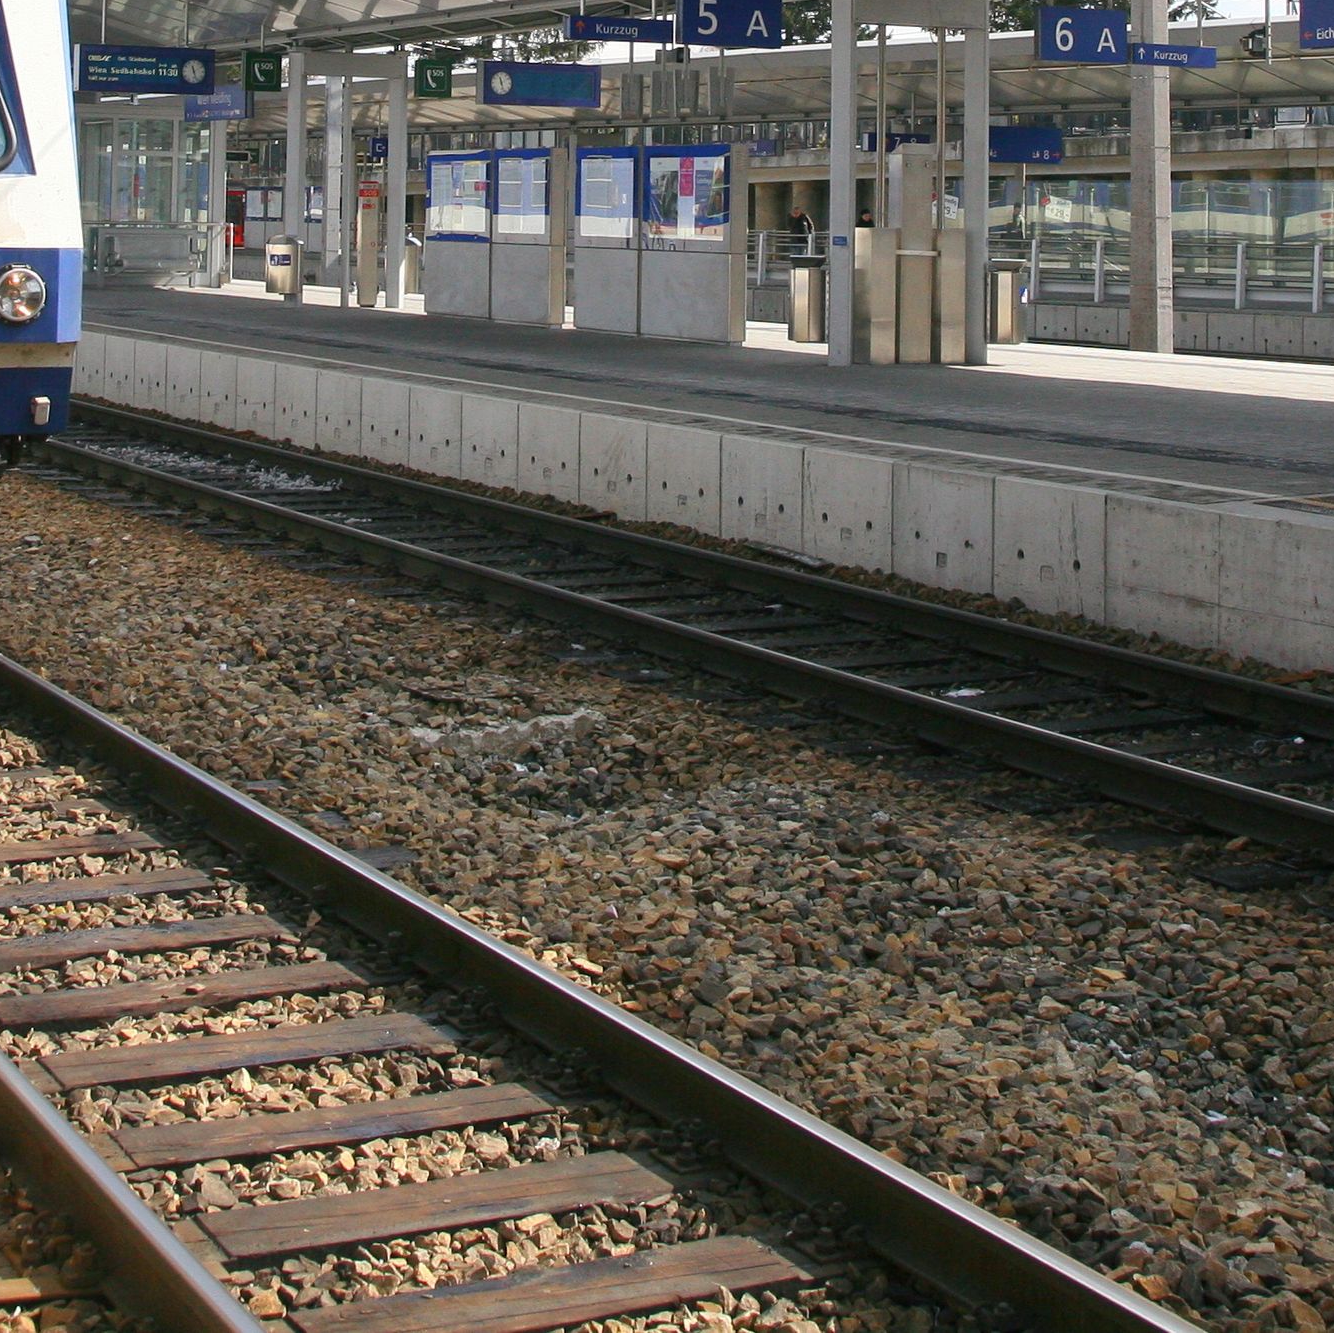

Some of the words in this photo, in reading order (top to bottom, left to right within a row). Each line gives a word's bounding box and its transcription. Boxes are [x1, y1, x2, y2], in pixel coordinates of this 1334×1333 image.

[746, 9, 768, 38] A
[595, 23, 639, 38] Kurzzug
[1055, 17, 1074, 52] 6
[1097, 27, 1116, 54] A
[1153, 49, 1188, 64] Kurzzug
[88, 66, 107, 74] Wien
[260, 62, 273, 70] SOS
[894, 137, 901, 148] 7
[1043, 149, 1050, 160] 8
